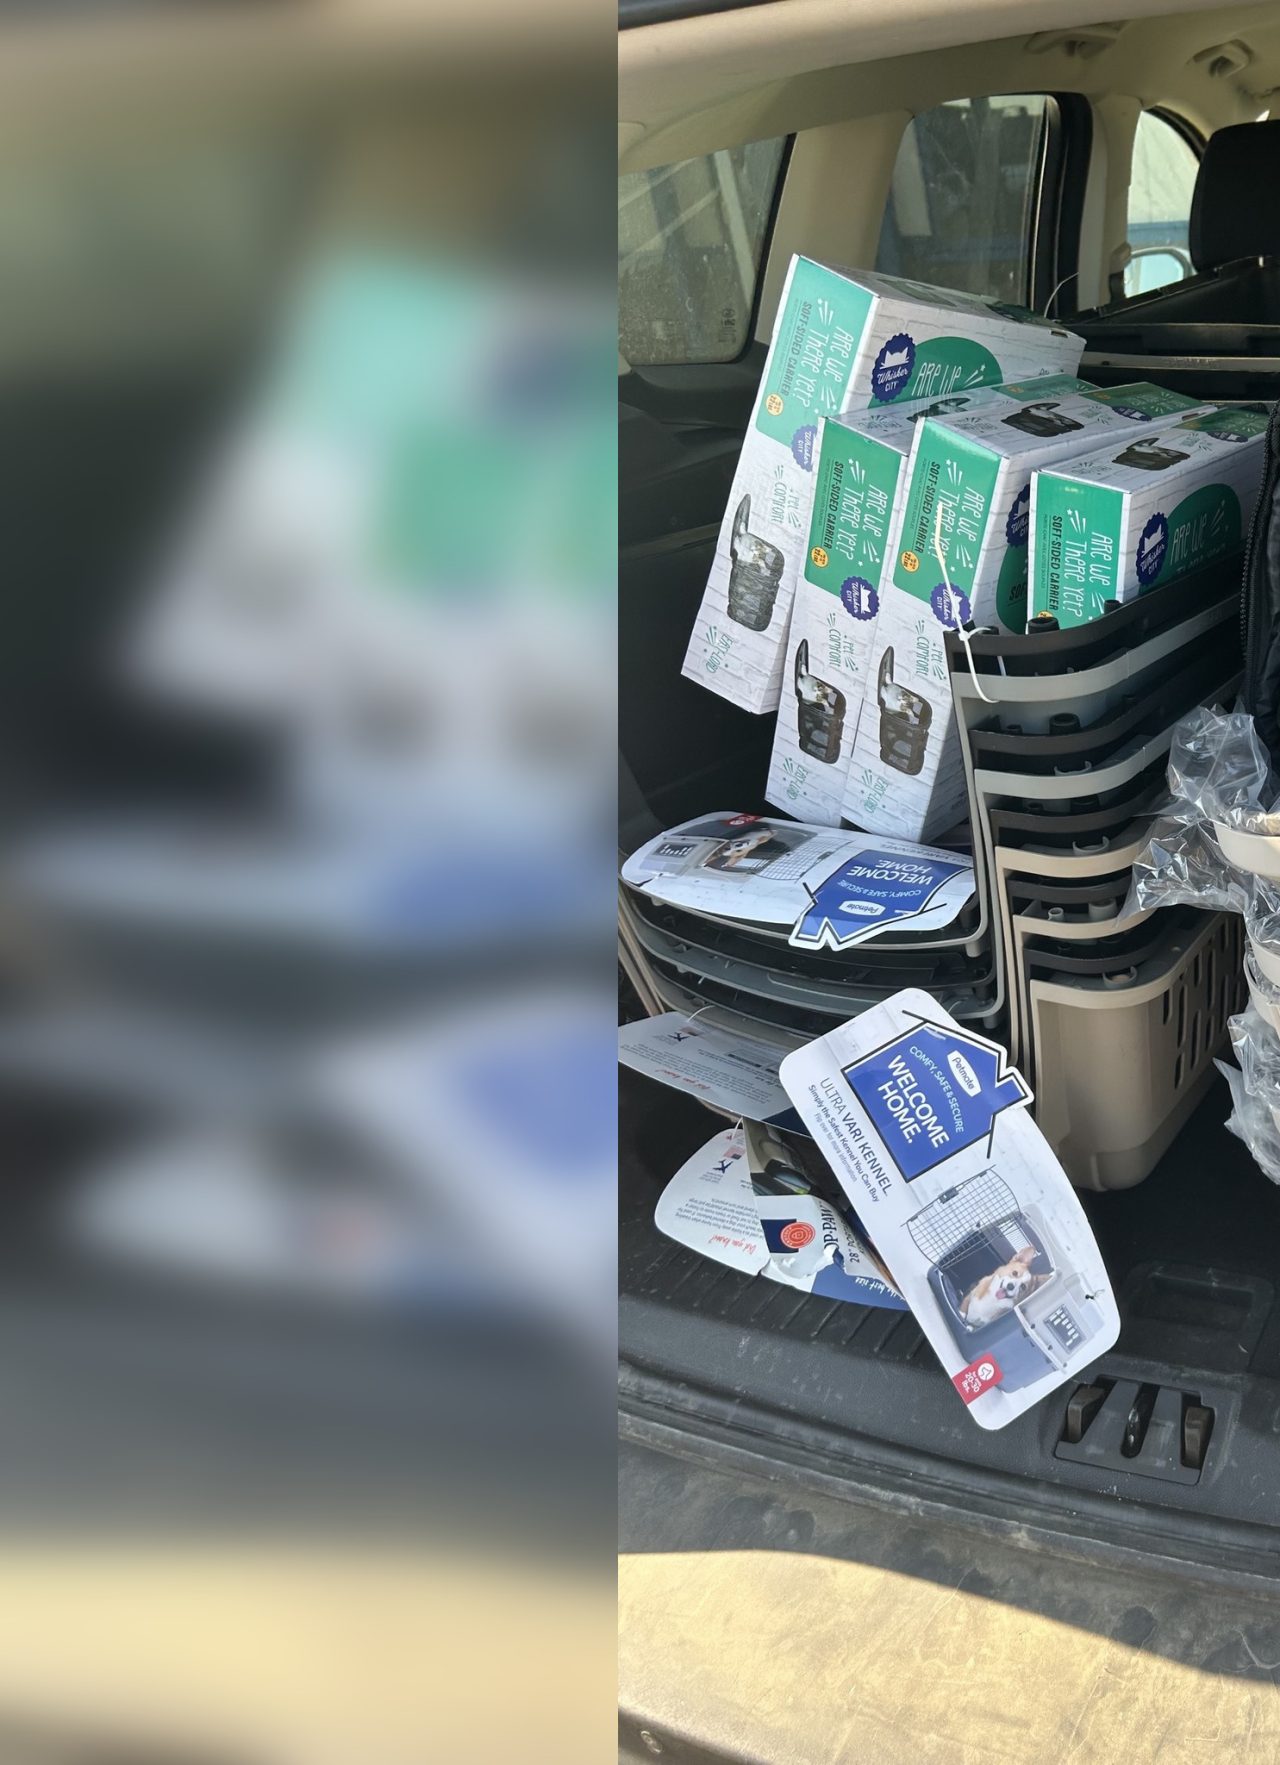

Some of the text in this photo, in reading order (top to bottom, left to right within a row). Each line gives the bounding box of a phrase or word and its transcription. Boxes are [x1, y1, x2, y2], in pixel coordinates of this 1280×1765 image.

[791, 301, 812, 355] SOFT-SIDED
[781, 357, 797, 396] CARRIER
[877, 368, 909, 385] Whisker
[885, 382, 897, 392] CITY
[830, 460, 844, 512] SOFT-SIDED
[924, 461, 940, 514] SOFT-SIDED
[823, 514, 837, 550] CARRIER
[914, 515, 930, 553] CARRIER
[1049, 515, 1063, 611] SOFT-SIDED CARRIER
[850, 582, 859, 614] Whisker
[943, 588, 952, 620] Whisker
[847, 865, 934, 885] WELCOME
[876, 859, 932, 873] HOME.
[909, 1046, 936, 1075] COMFY,
[934, 1071, 952, 1093] SAFE
[948, 1098, 964, 1133] SECURE
[951, 1057, 975, 1090] Petmate
[878, 1080, 921, 1144] HOME.
[888, 1055, 950, 1149] WELCOME
[808, 1084, 880, 1203] Simply the Safest Kennel You Can Buy
[820, 1077, 893, 1195] ULTRA VARI KENNEL
[964, 1371, 980, 1393] 20-30
